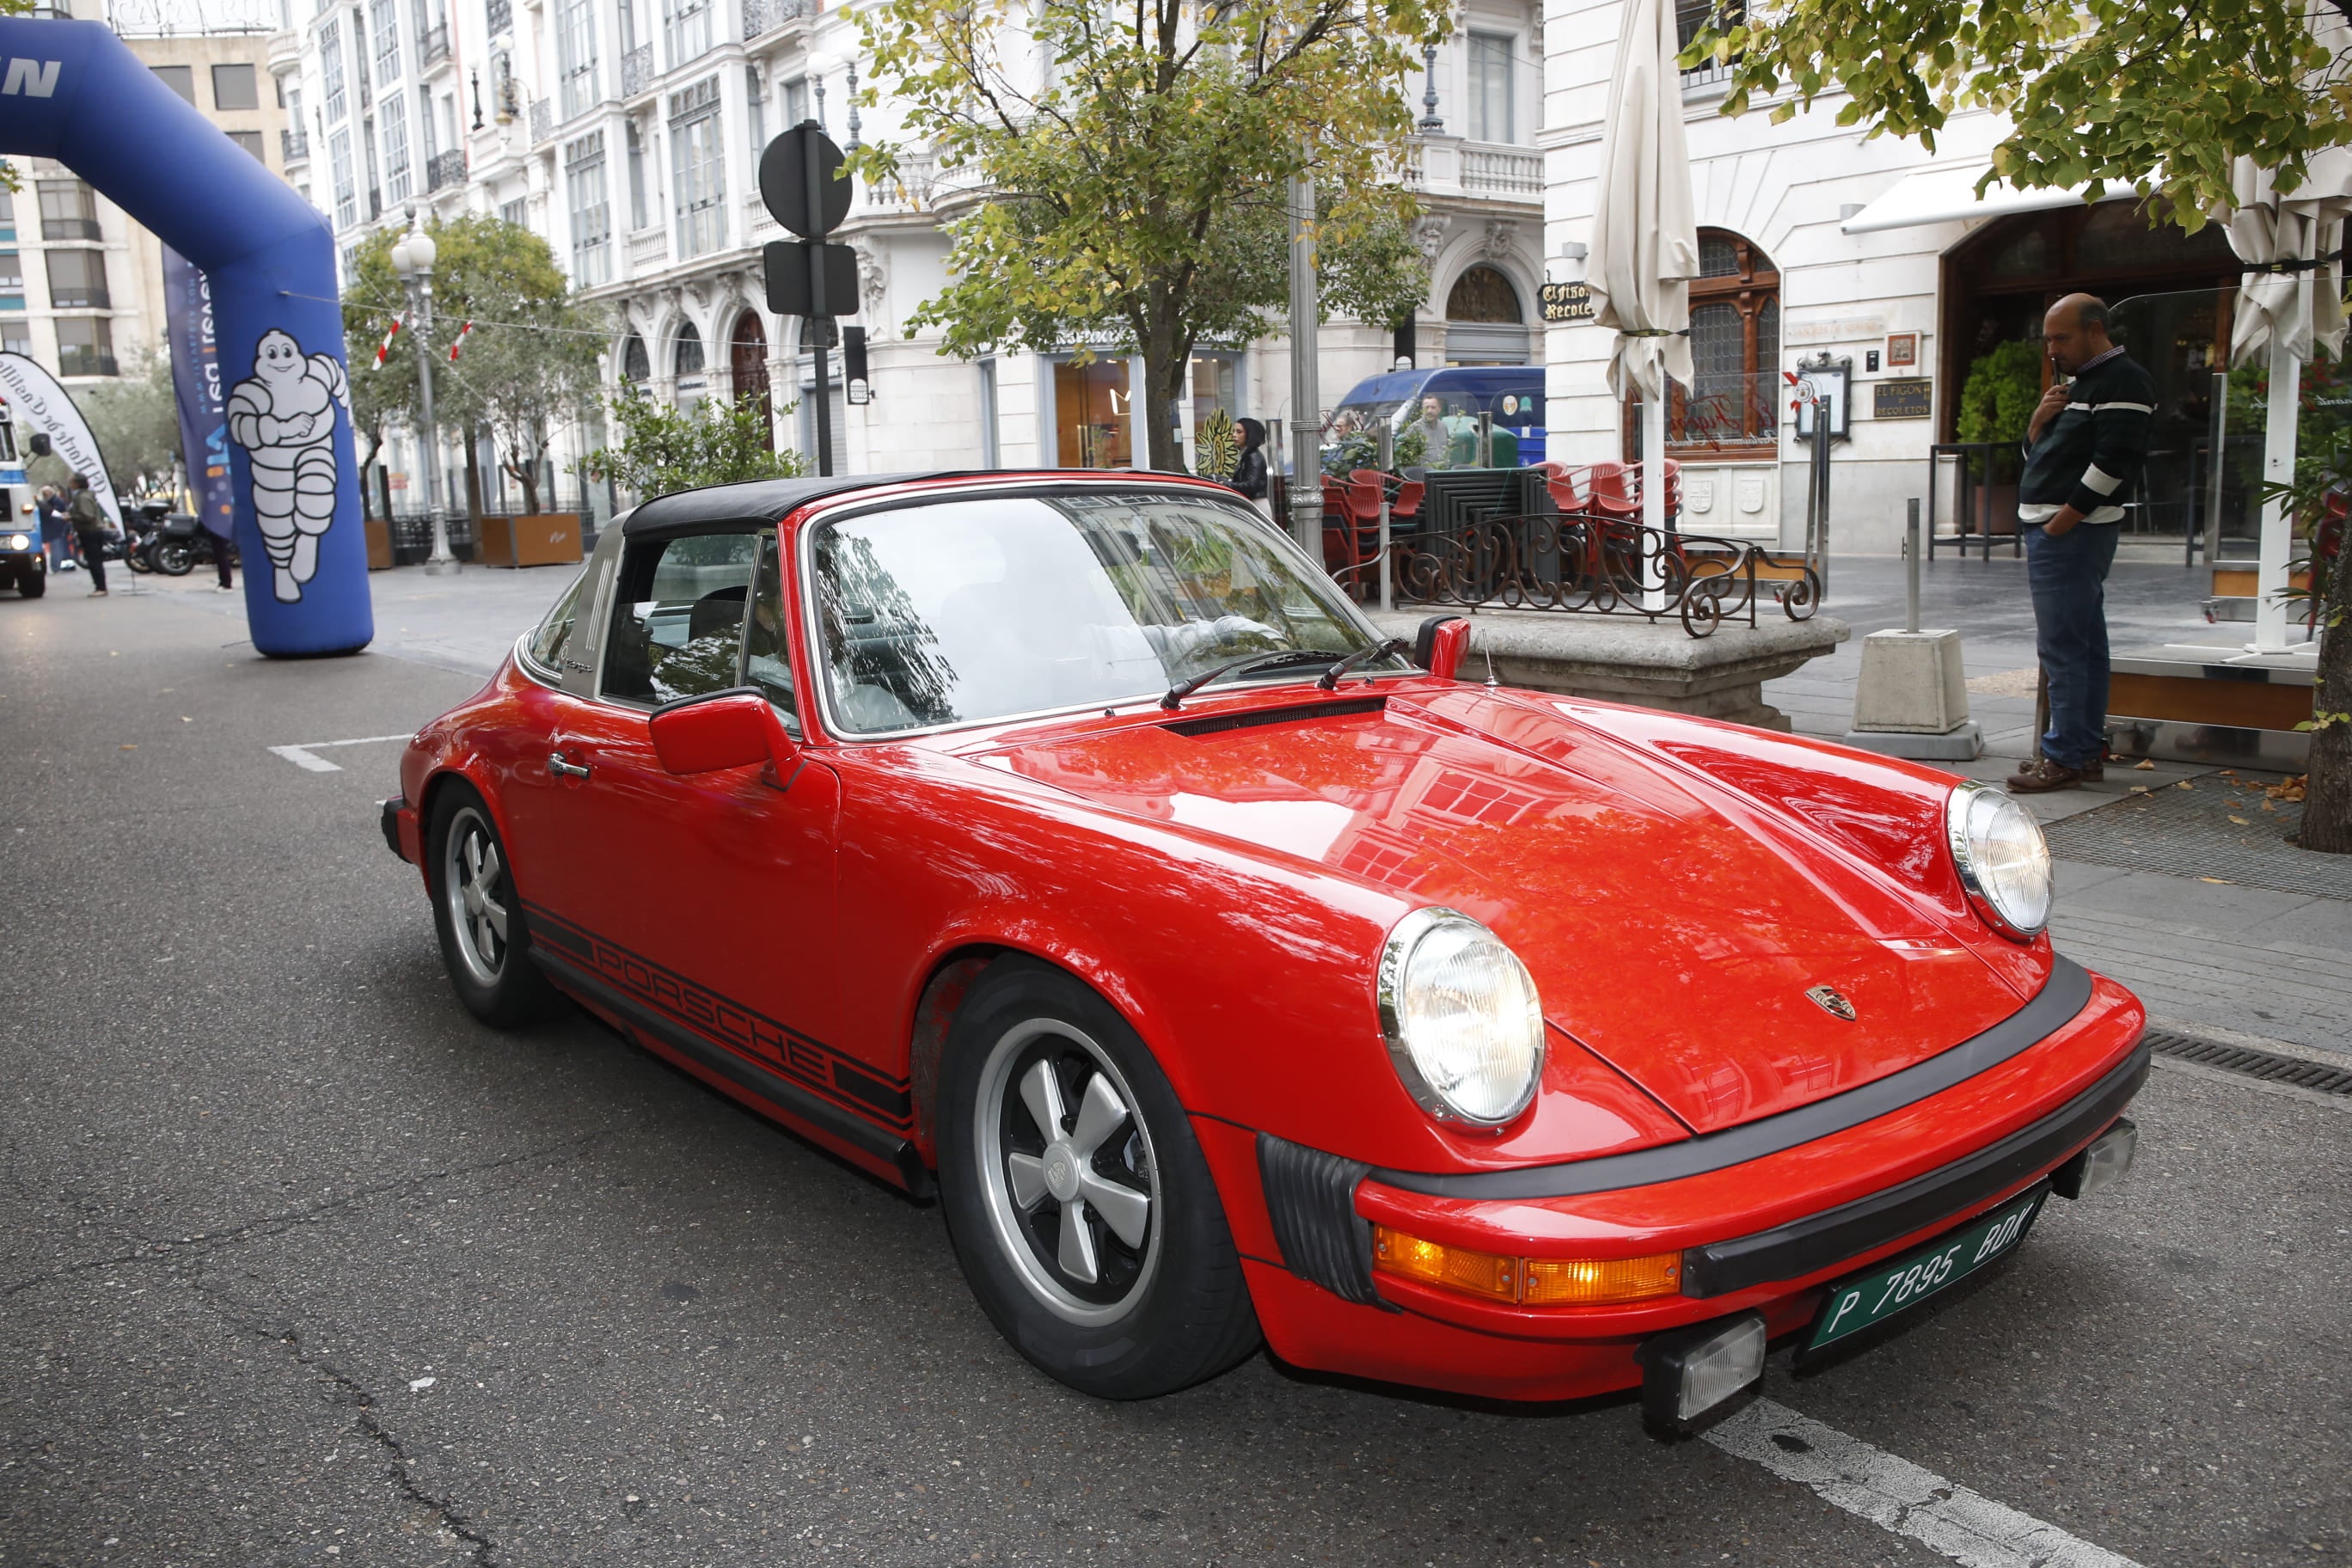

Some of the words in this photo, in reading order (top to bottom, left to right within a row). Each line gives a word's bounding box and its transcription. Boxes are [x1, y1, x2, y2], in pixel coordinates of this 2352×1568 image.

[1545, 302, 1596, 320] Recole
[1877, 386, 1888, 396] EL
[1876, 405, 1929, 416] RECOLETOS
[597, 944, 829, 1082] PORSCHE
[1828, 1290, 1860, 1333] P
[1871, 1244, 1962, 1315] 7895
